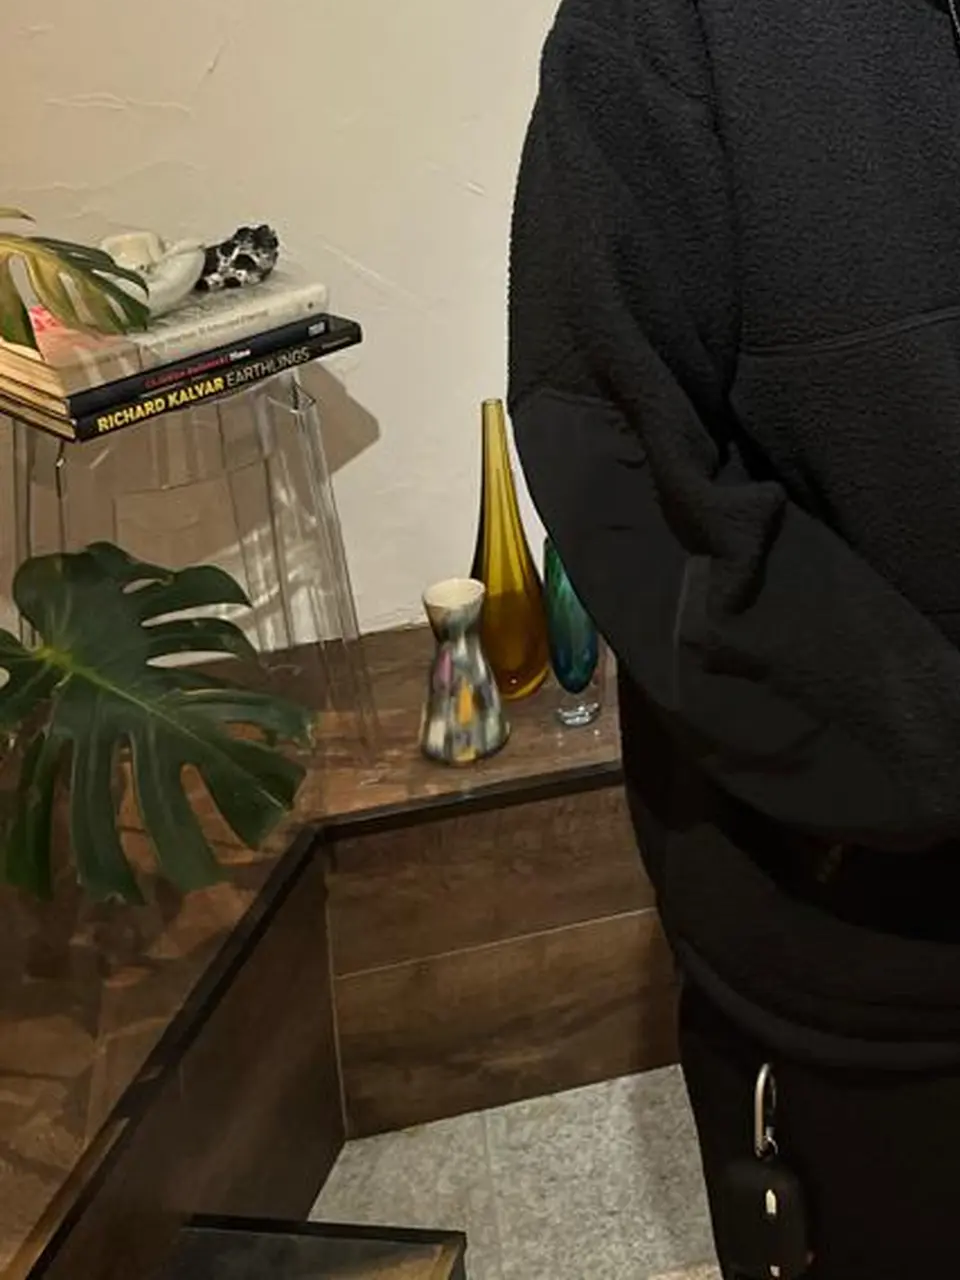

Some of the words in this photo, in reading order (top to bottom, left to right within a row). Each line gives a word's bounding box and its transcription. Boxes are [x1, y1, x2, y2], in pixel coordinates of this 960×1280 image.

[96, 397, 166, 434] RICHARD
[168, 376, 226, 410] KALVAR
[226, 346, 311, 387] EARTHLINGS
